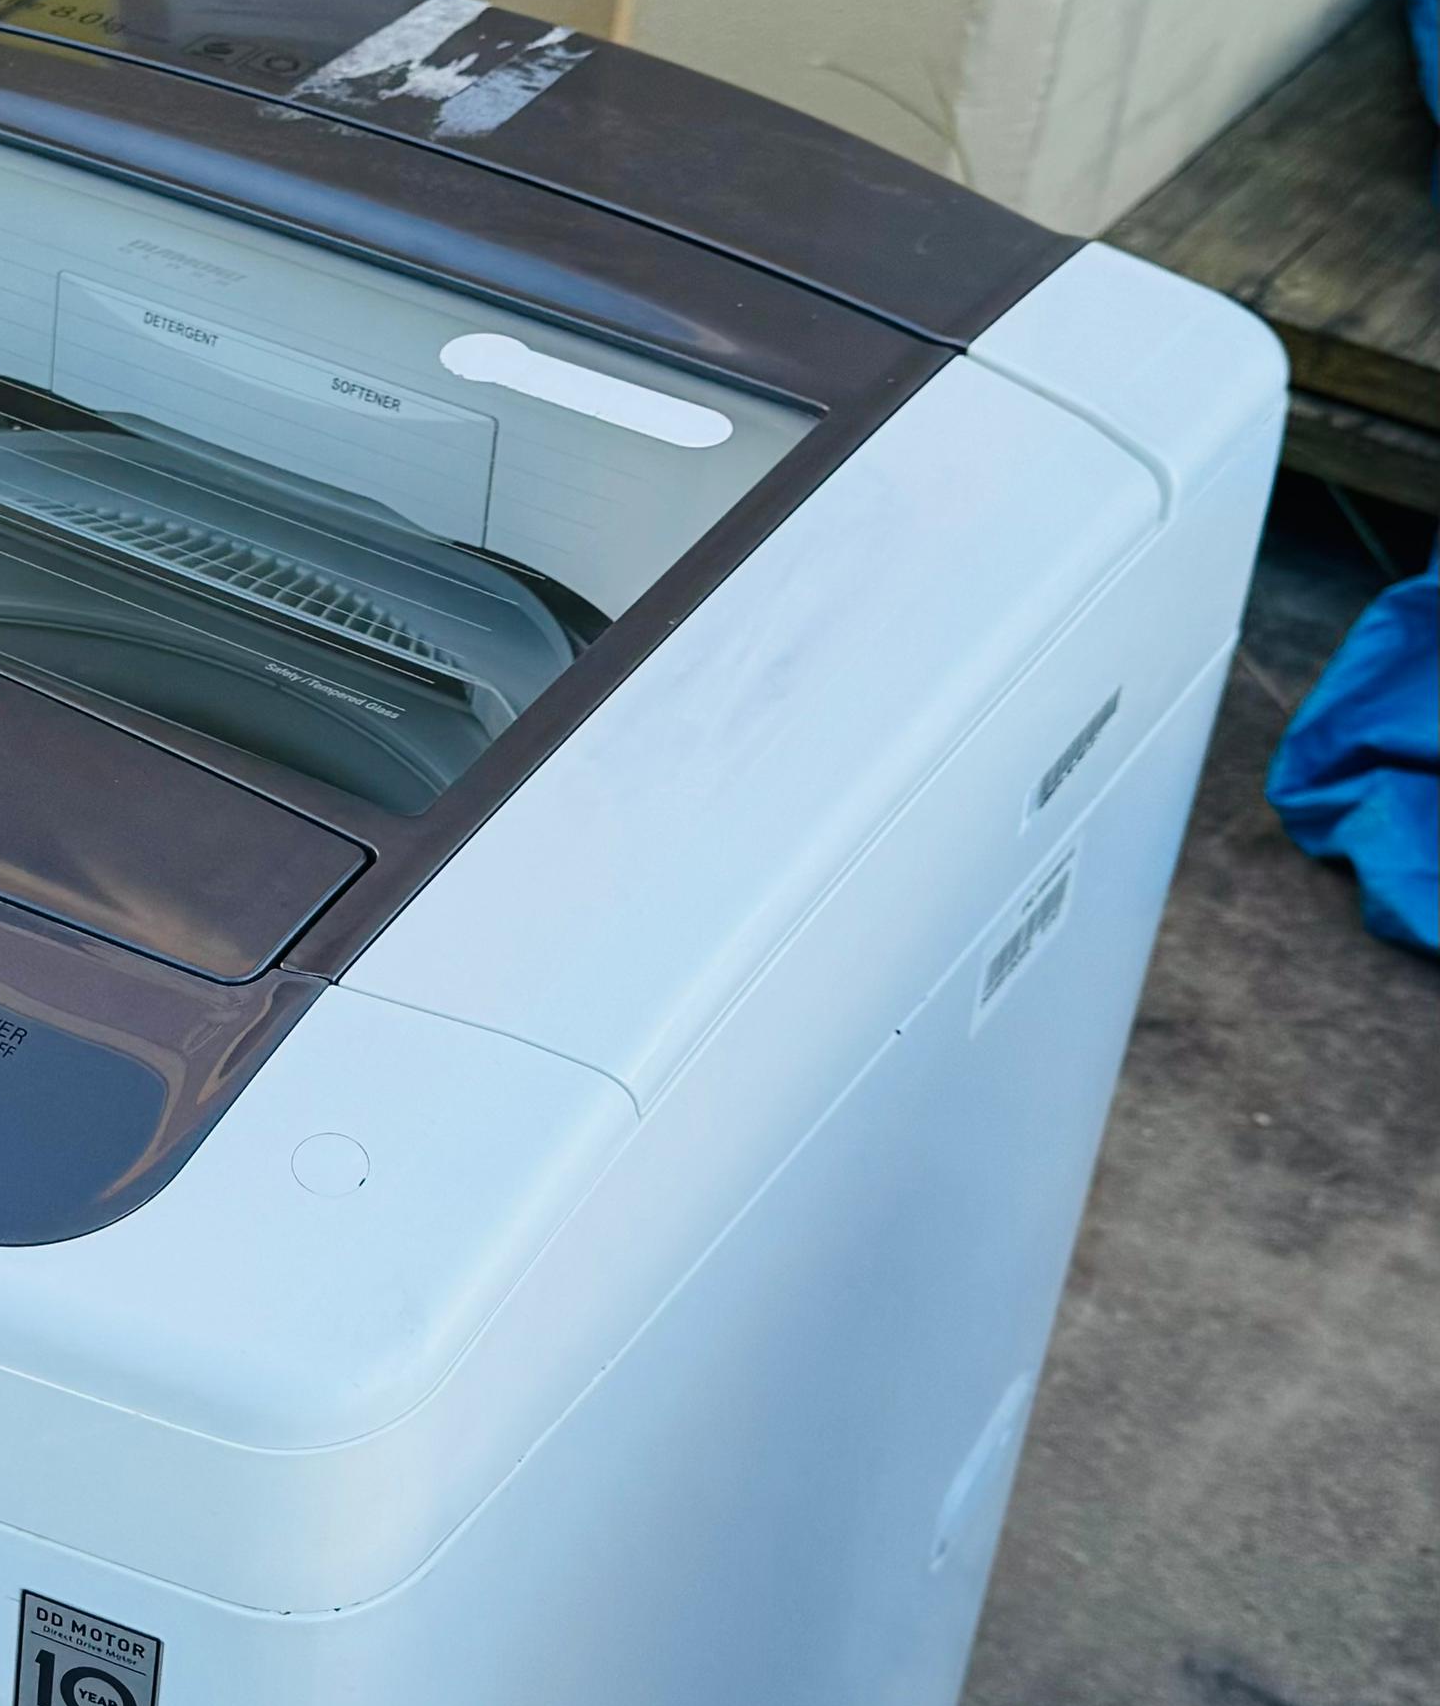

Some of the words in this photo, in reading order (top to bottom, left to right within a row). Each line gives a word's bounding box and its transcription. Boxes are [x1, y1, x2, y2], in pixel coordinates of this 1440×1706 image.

[143, 310, 218, 347] DETERGENT
[331, 376, 402, 413] SOFTENER
[36, 1607, 63, 1626] DD
[71, 1619, 145, 1658] MOTOR
[43, 1625, 73, 1643] Direct
[76, 1638, 102, 1654] Drive
[105, 1648, 138, 1666] Motor
